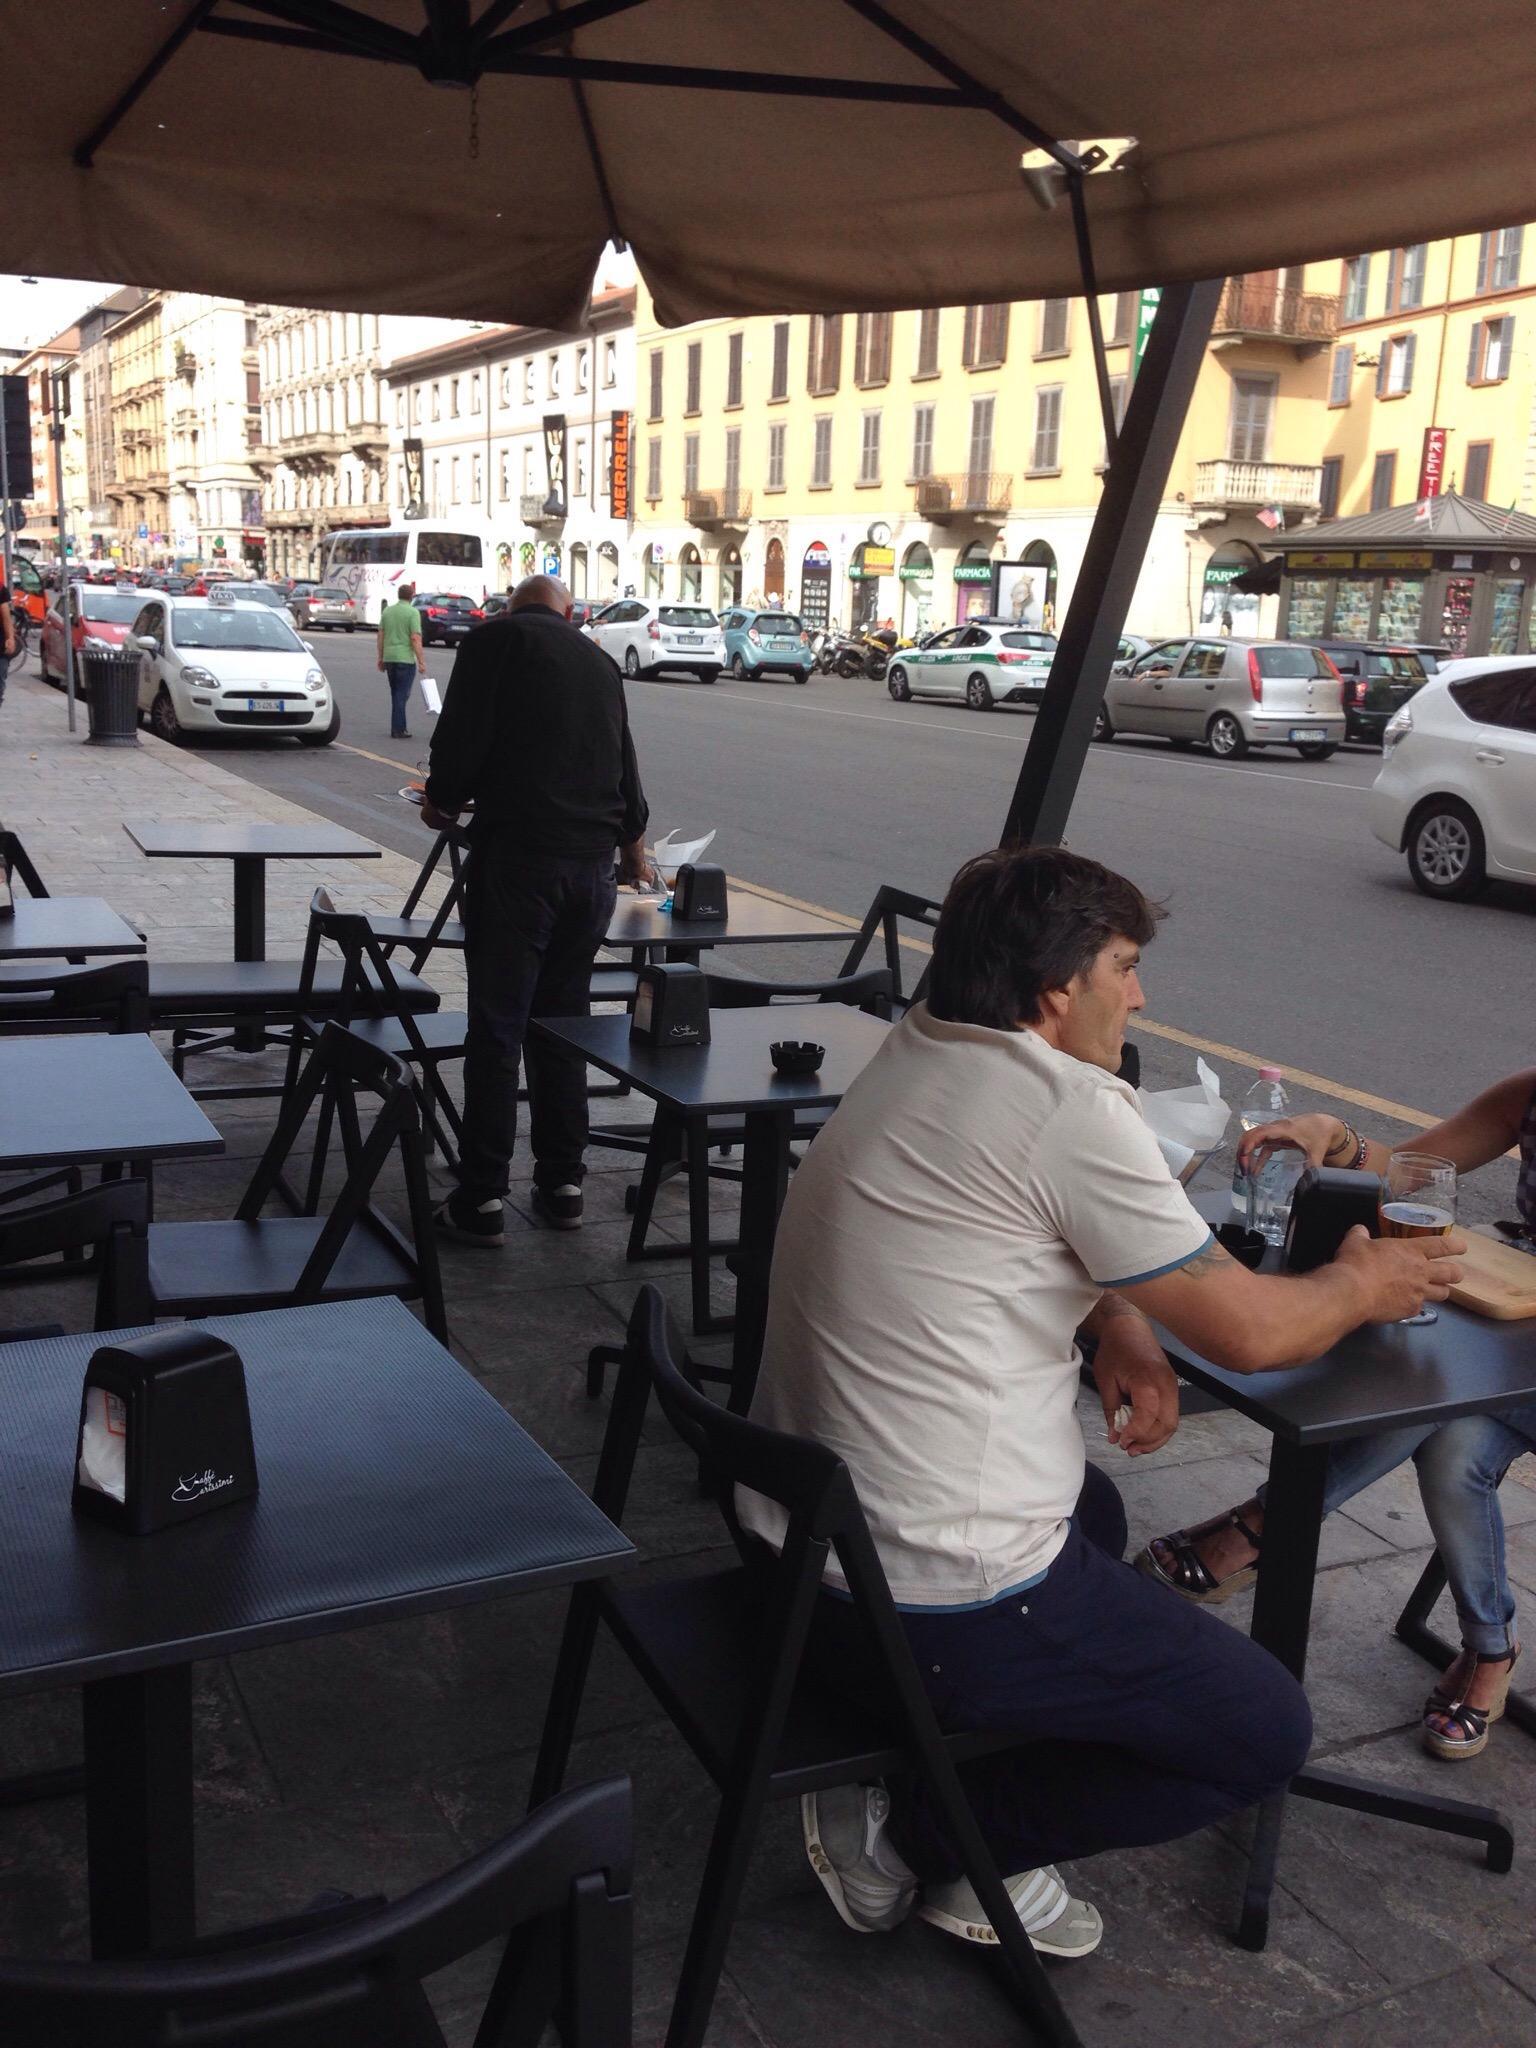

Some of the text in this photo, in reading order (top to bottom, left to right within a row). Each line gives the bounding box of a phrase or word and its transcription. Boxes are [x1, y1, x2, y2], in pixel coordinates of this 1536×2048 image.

[613, 411, 629, 519] MERRELL
[1206, 570, 1241, 581] FARM
[210, 591, 234, 601] TAXI
